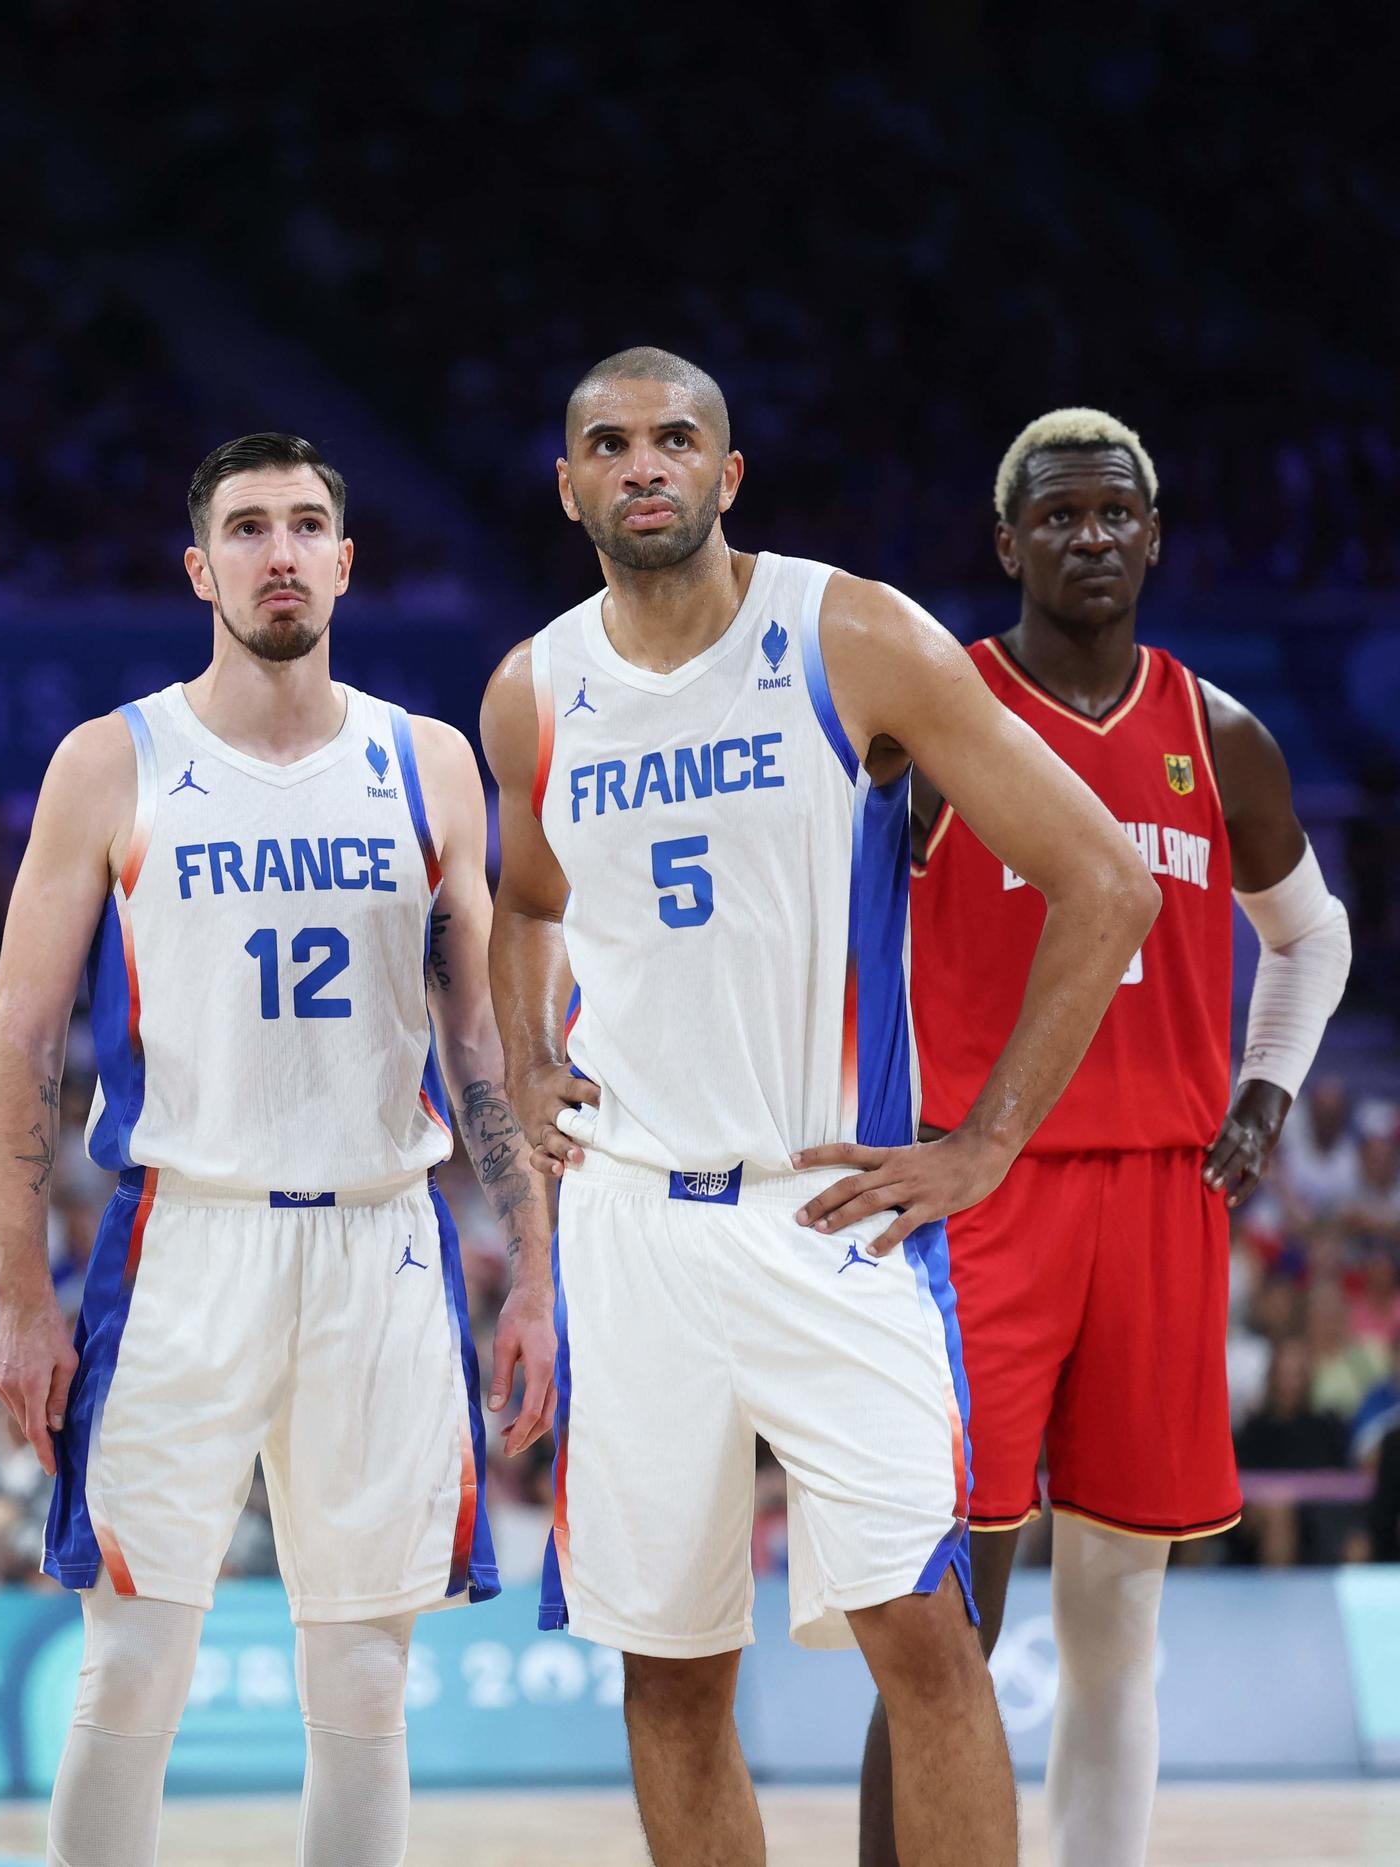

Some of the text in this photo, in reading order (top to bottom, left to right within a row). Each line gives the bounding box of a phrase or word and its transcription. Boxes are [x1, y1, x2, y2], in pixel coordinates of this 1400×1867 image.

[757, 675, 792, 691] FRANCE
[367, 786, 398, 800] FRANCE
[570, 732, 785, 824] FRANCE
[175, 837, 397, 899] FRANCE
[651, 835, 714, 929] 5
[244, 927, 352, 1020] 12
